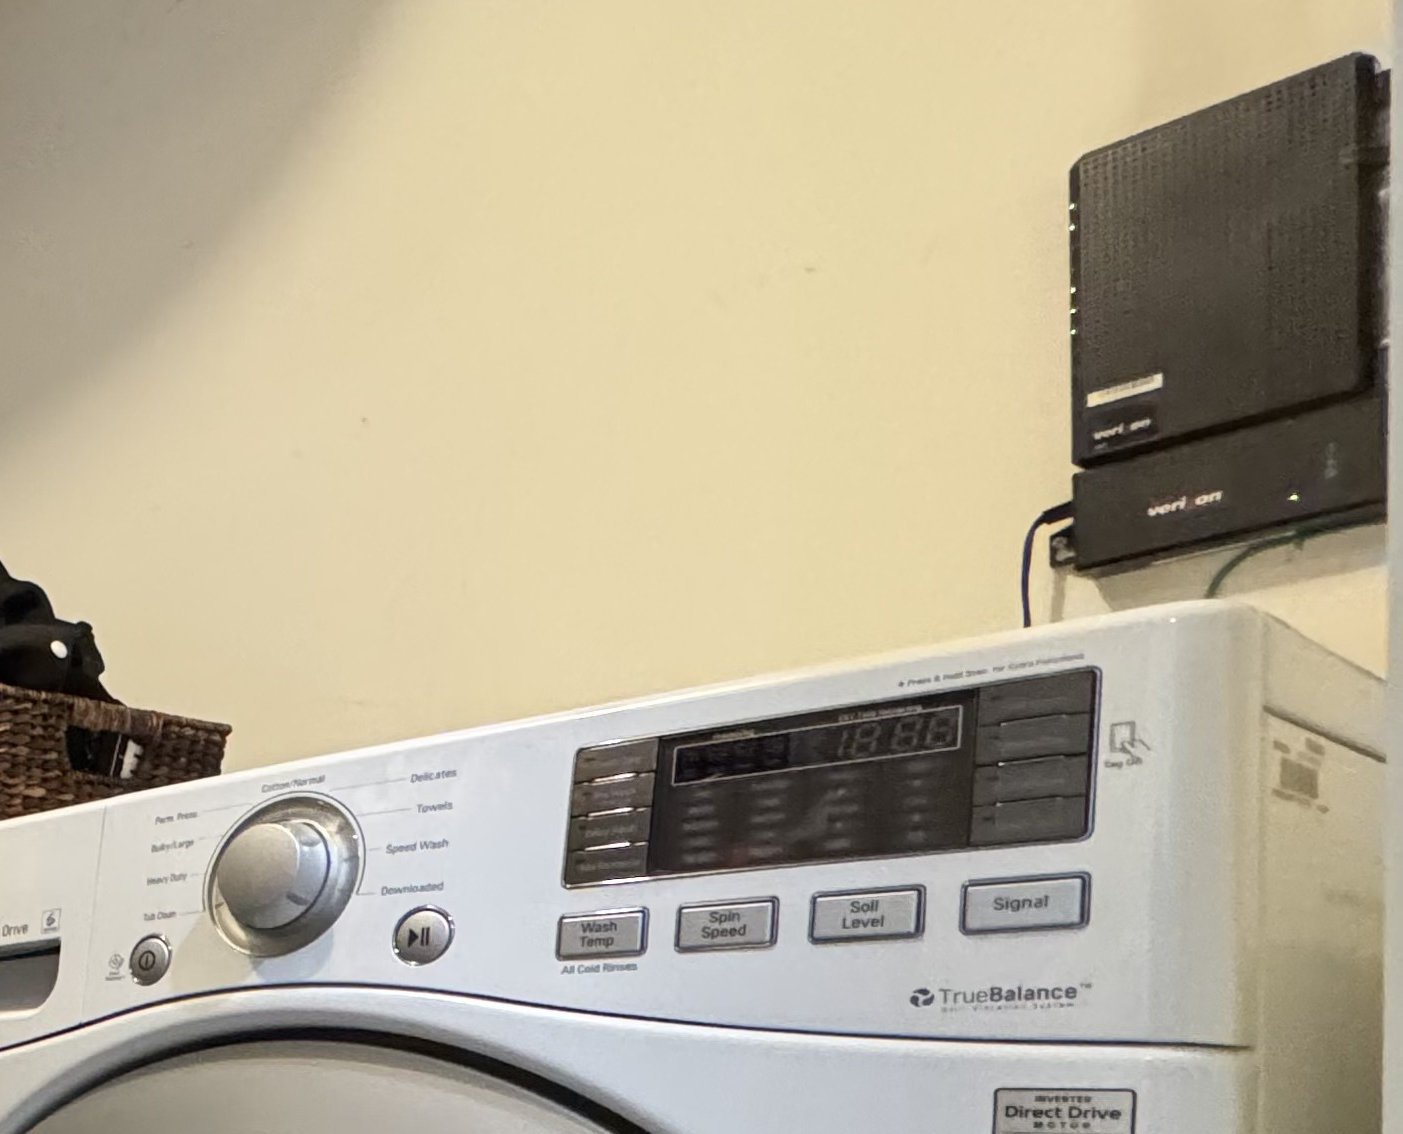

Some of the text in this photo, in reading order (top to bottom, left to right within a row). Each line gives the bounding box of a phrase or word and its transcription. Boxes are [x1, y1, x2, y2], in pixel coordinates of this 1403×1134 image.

[1147, 490, 1223, 516] verion
[410, 769, 457, 783] Delicates
[417, 801, 453, 813] Towels
[386, 838, 449, 855] Speed Wash
[147, 872, 188, 887] Heavy Duty
[381, 880, 444, 896] Downloaded
[850, 899, 879, 913] Soil
[993, 895, 1049, 912] Signal
[709, 911, 741, 925] Spin
[841, 915, 885, 930] Level
[2, 924, 29, 938] Drive
[580, 922, 618, 934] Wash
[701, 924, 747, 940] Speed
[580, 936, 615, 949] Temp
[561, 963, 638, 975] All Cold Rinses
[939, 984, 1078, 1005] TrueBalance
[1005, 1105, 1122, 1120] Direct Drive
[1033, 1121, 1091, 1129] MOTOR
